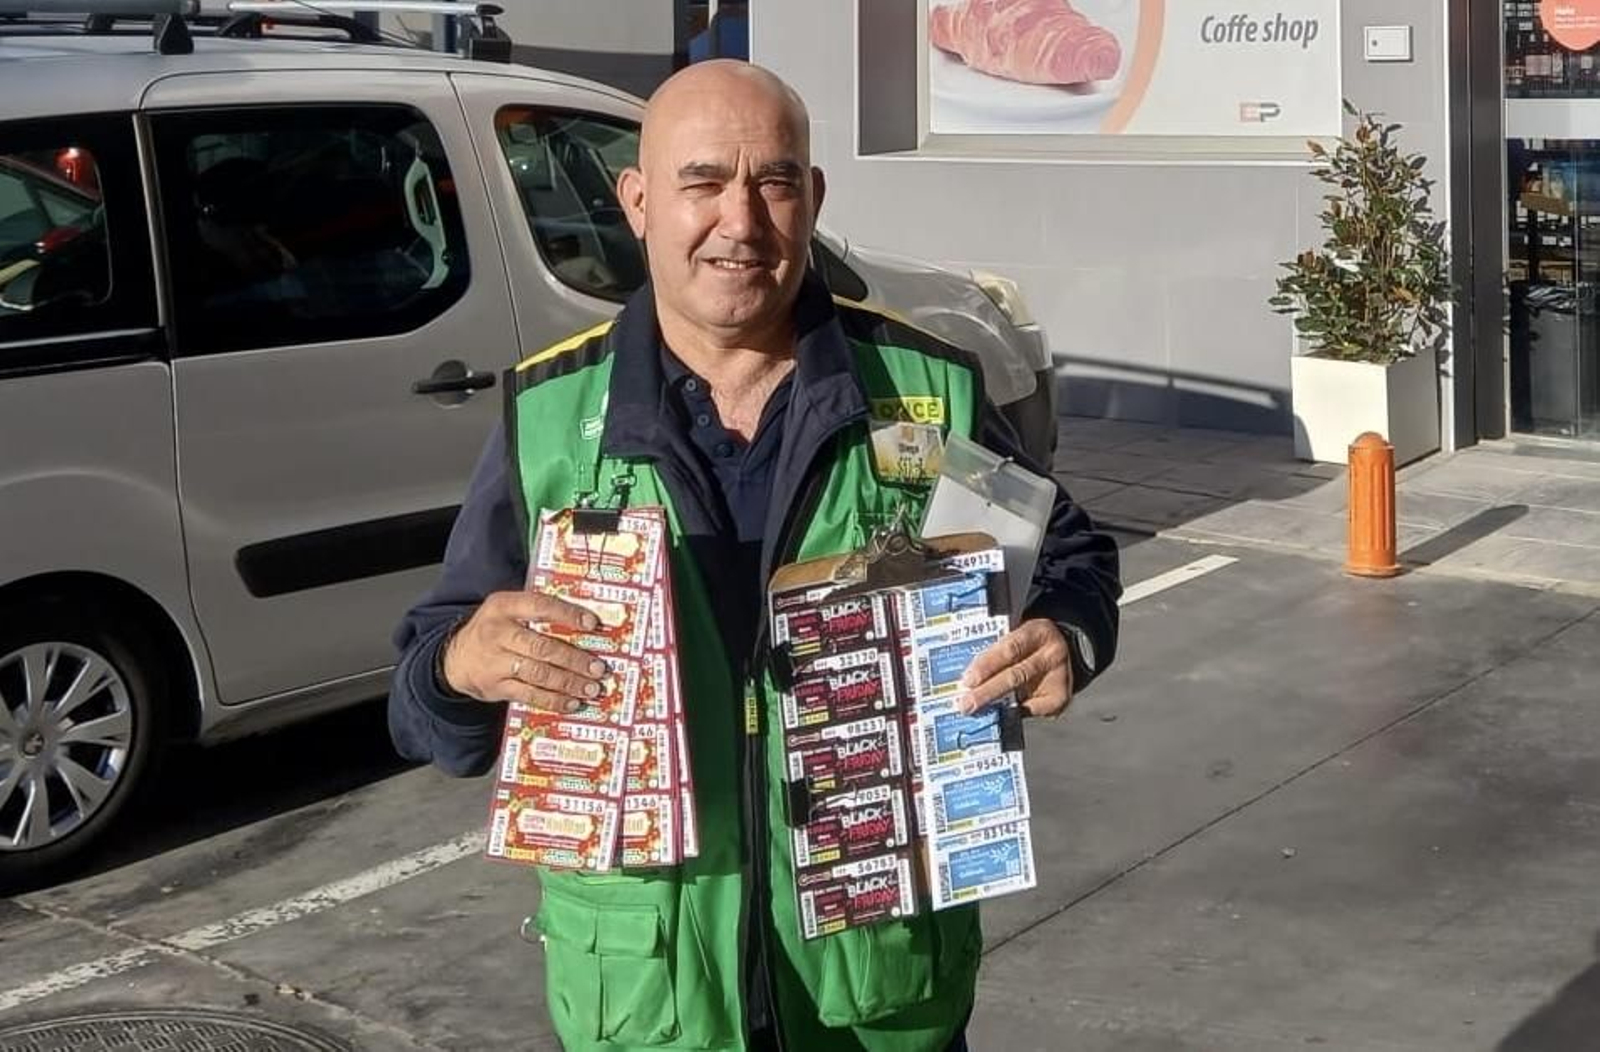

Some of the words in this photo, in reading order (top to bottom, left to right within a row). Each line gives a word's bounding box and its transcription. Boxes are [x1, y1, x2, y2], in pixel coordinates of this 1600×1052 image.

[1201, 14, 1258, 43] Coffe
[1262, 13, 1319, 49] shop
[830, 670, 870, 690] BLACK
[634, 726, 654, 738] 46
[838, 739, 878, 759] BLACK
[842, 807, 882, 829] BLACK
[848, 877, 888, 898] BLACK
